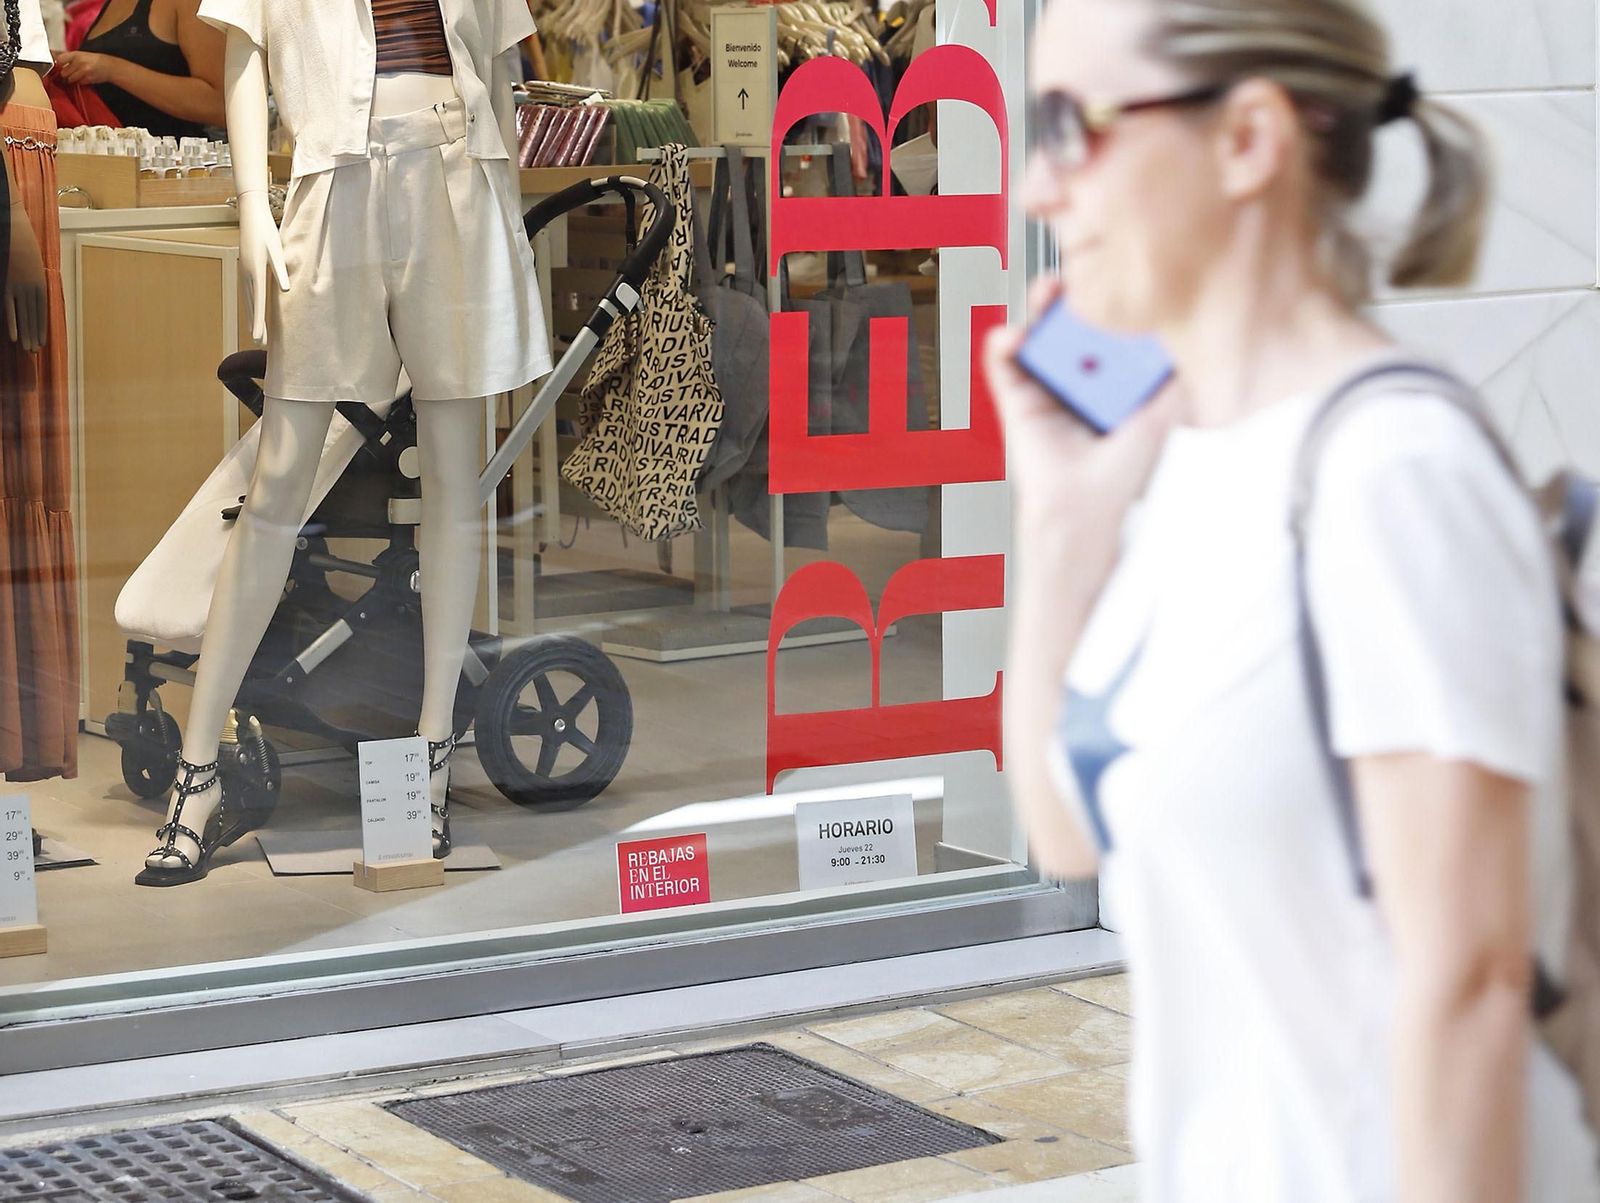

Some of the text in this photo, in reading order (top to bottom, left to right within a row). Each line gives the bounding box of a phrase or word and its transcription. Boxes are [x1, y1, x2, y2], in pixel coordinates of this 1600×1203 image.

[725, 43, 762, 52] Bienvenido
[727, 59, 758, 68] Welcome
[818, 818, 894, 839] HORARIO
[628, 845, 696, 868] REBAJAS
[838, 843, 874, 854] Jueves 22
[830, 857, 851, 867] 9:00
[861, 854, 886, 865] 21:30
[629, 865, 671, 884] EN EL
[630, 877, 700, 900] INTERIOR
